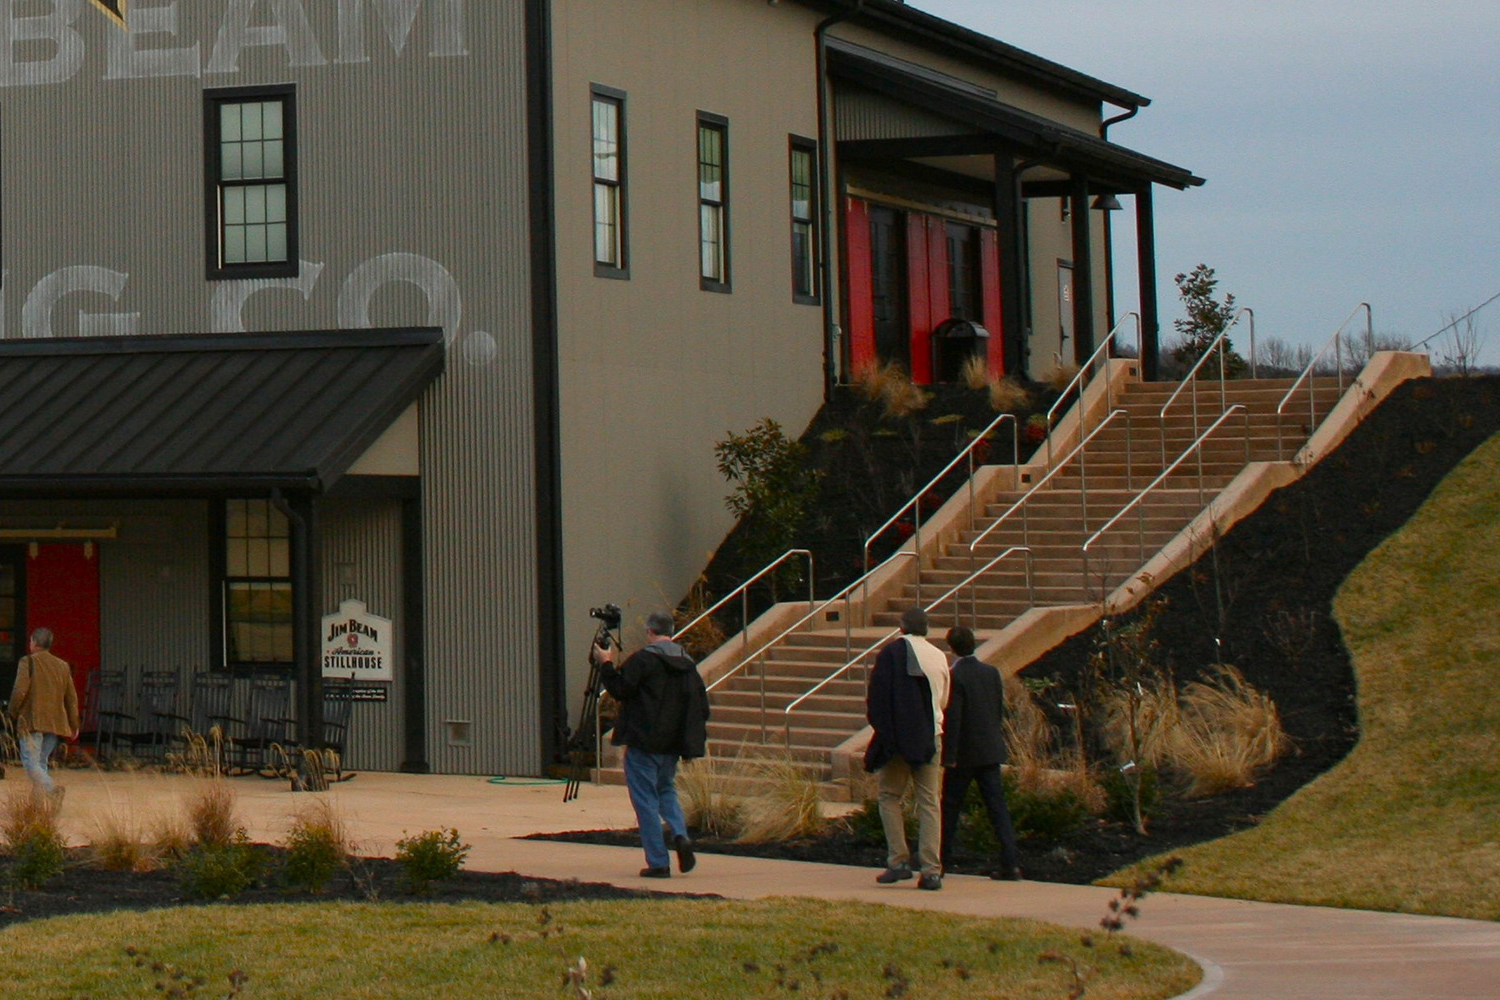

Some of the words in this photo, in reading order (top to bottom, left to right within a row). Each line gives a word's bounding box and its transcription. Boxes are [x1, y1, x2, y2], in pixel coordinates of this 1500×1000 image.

[327, 622, 348, 642] JIM
[348, 618, 378, 643] BEAM
[324, 655, 383, 669] STILLHOUSE
